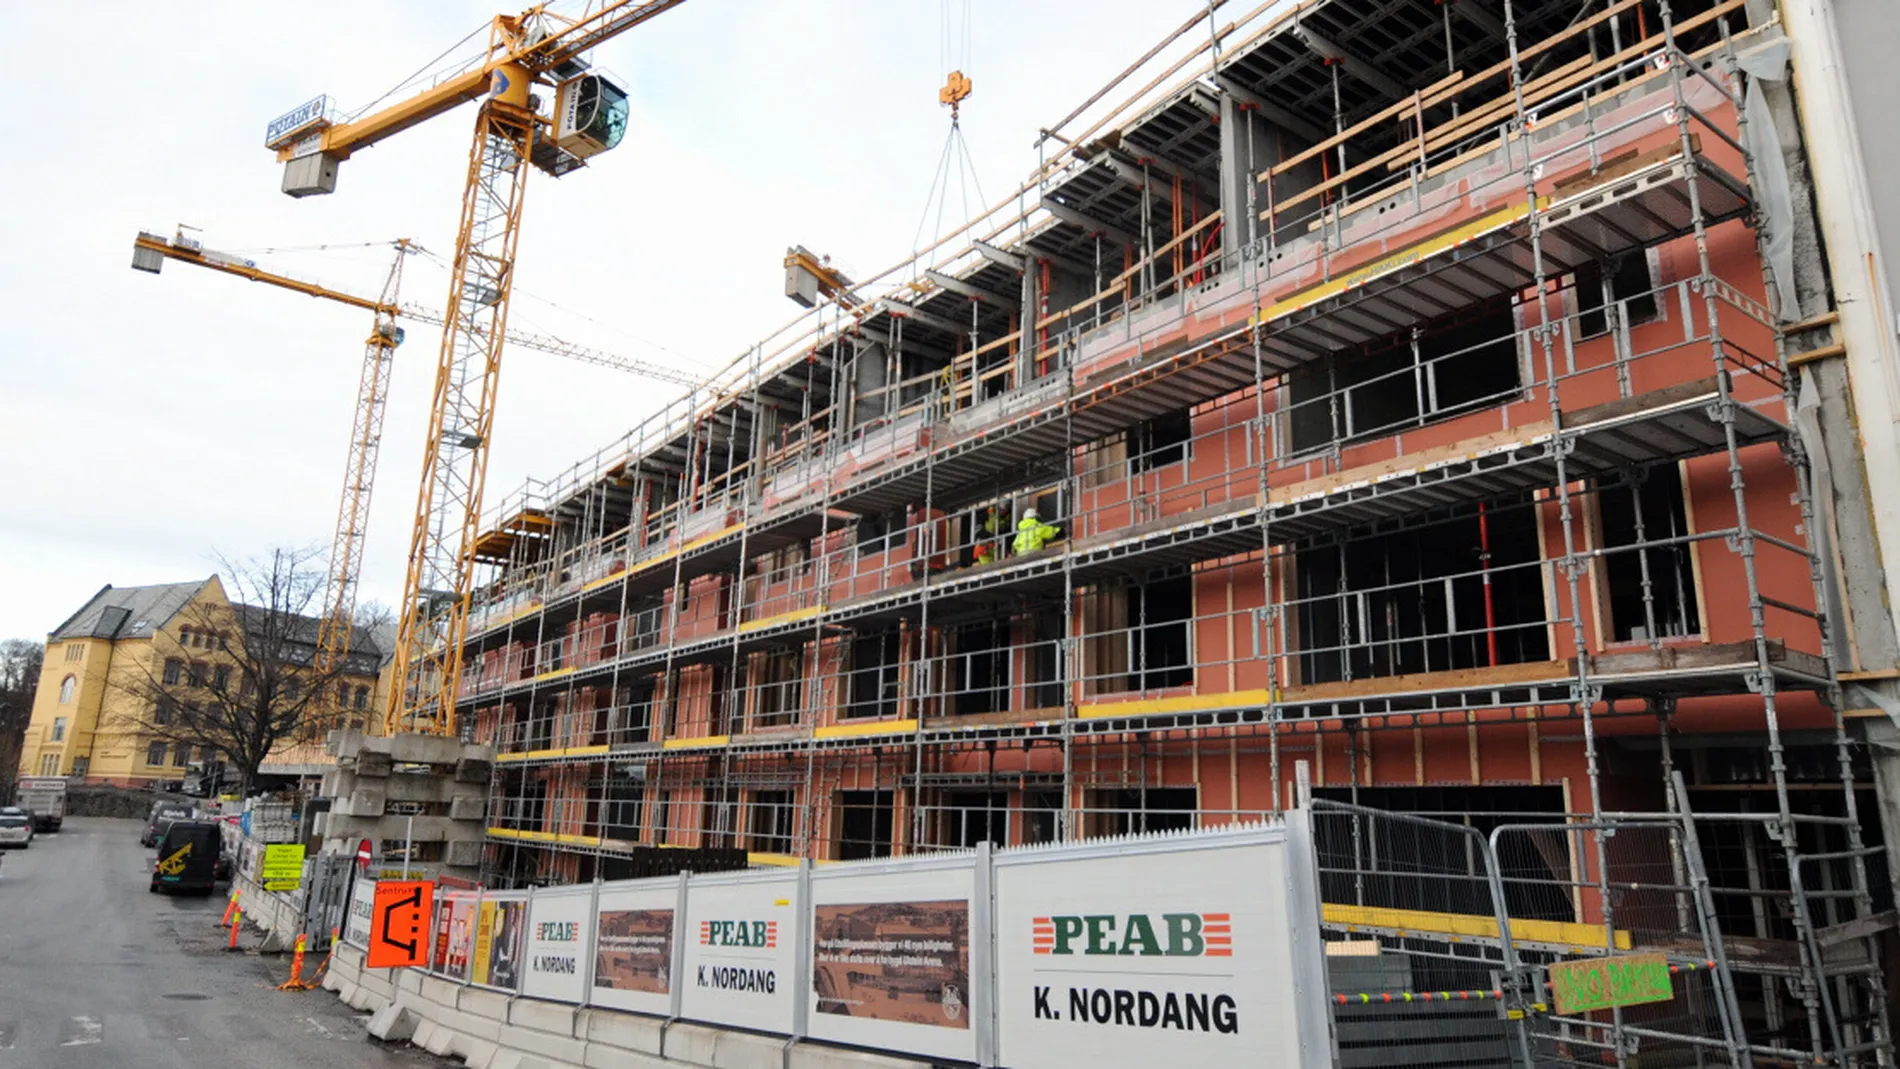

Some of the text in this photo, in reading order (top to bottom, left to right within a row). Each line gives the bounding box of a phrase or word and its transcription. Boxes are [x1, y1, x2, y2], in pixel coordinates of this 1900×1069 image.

[268, 104, 312, 136] POTAIN
[567, 90, 577, 130] POTAIN
[541, 921, 573, 941] PEAB
[708, 920, 767, 948] PEAB
[1051, 913, 1204, 956] PEAB
[541, 955, 575, 974] NORDANG
[697, 964, 776, 994] K. NORDANG
[1034, 986, 1239, 1034] K. NORDANG
